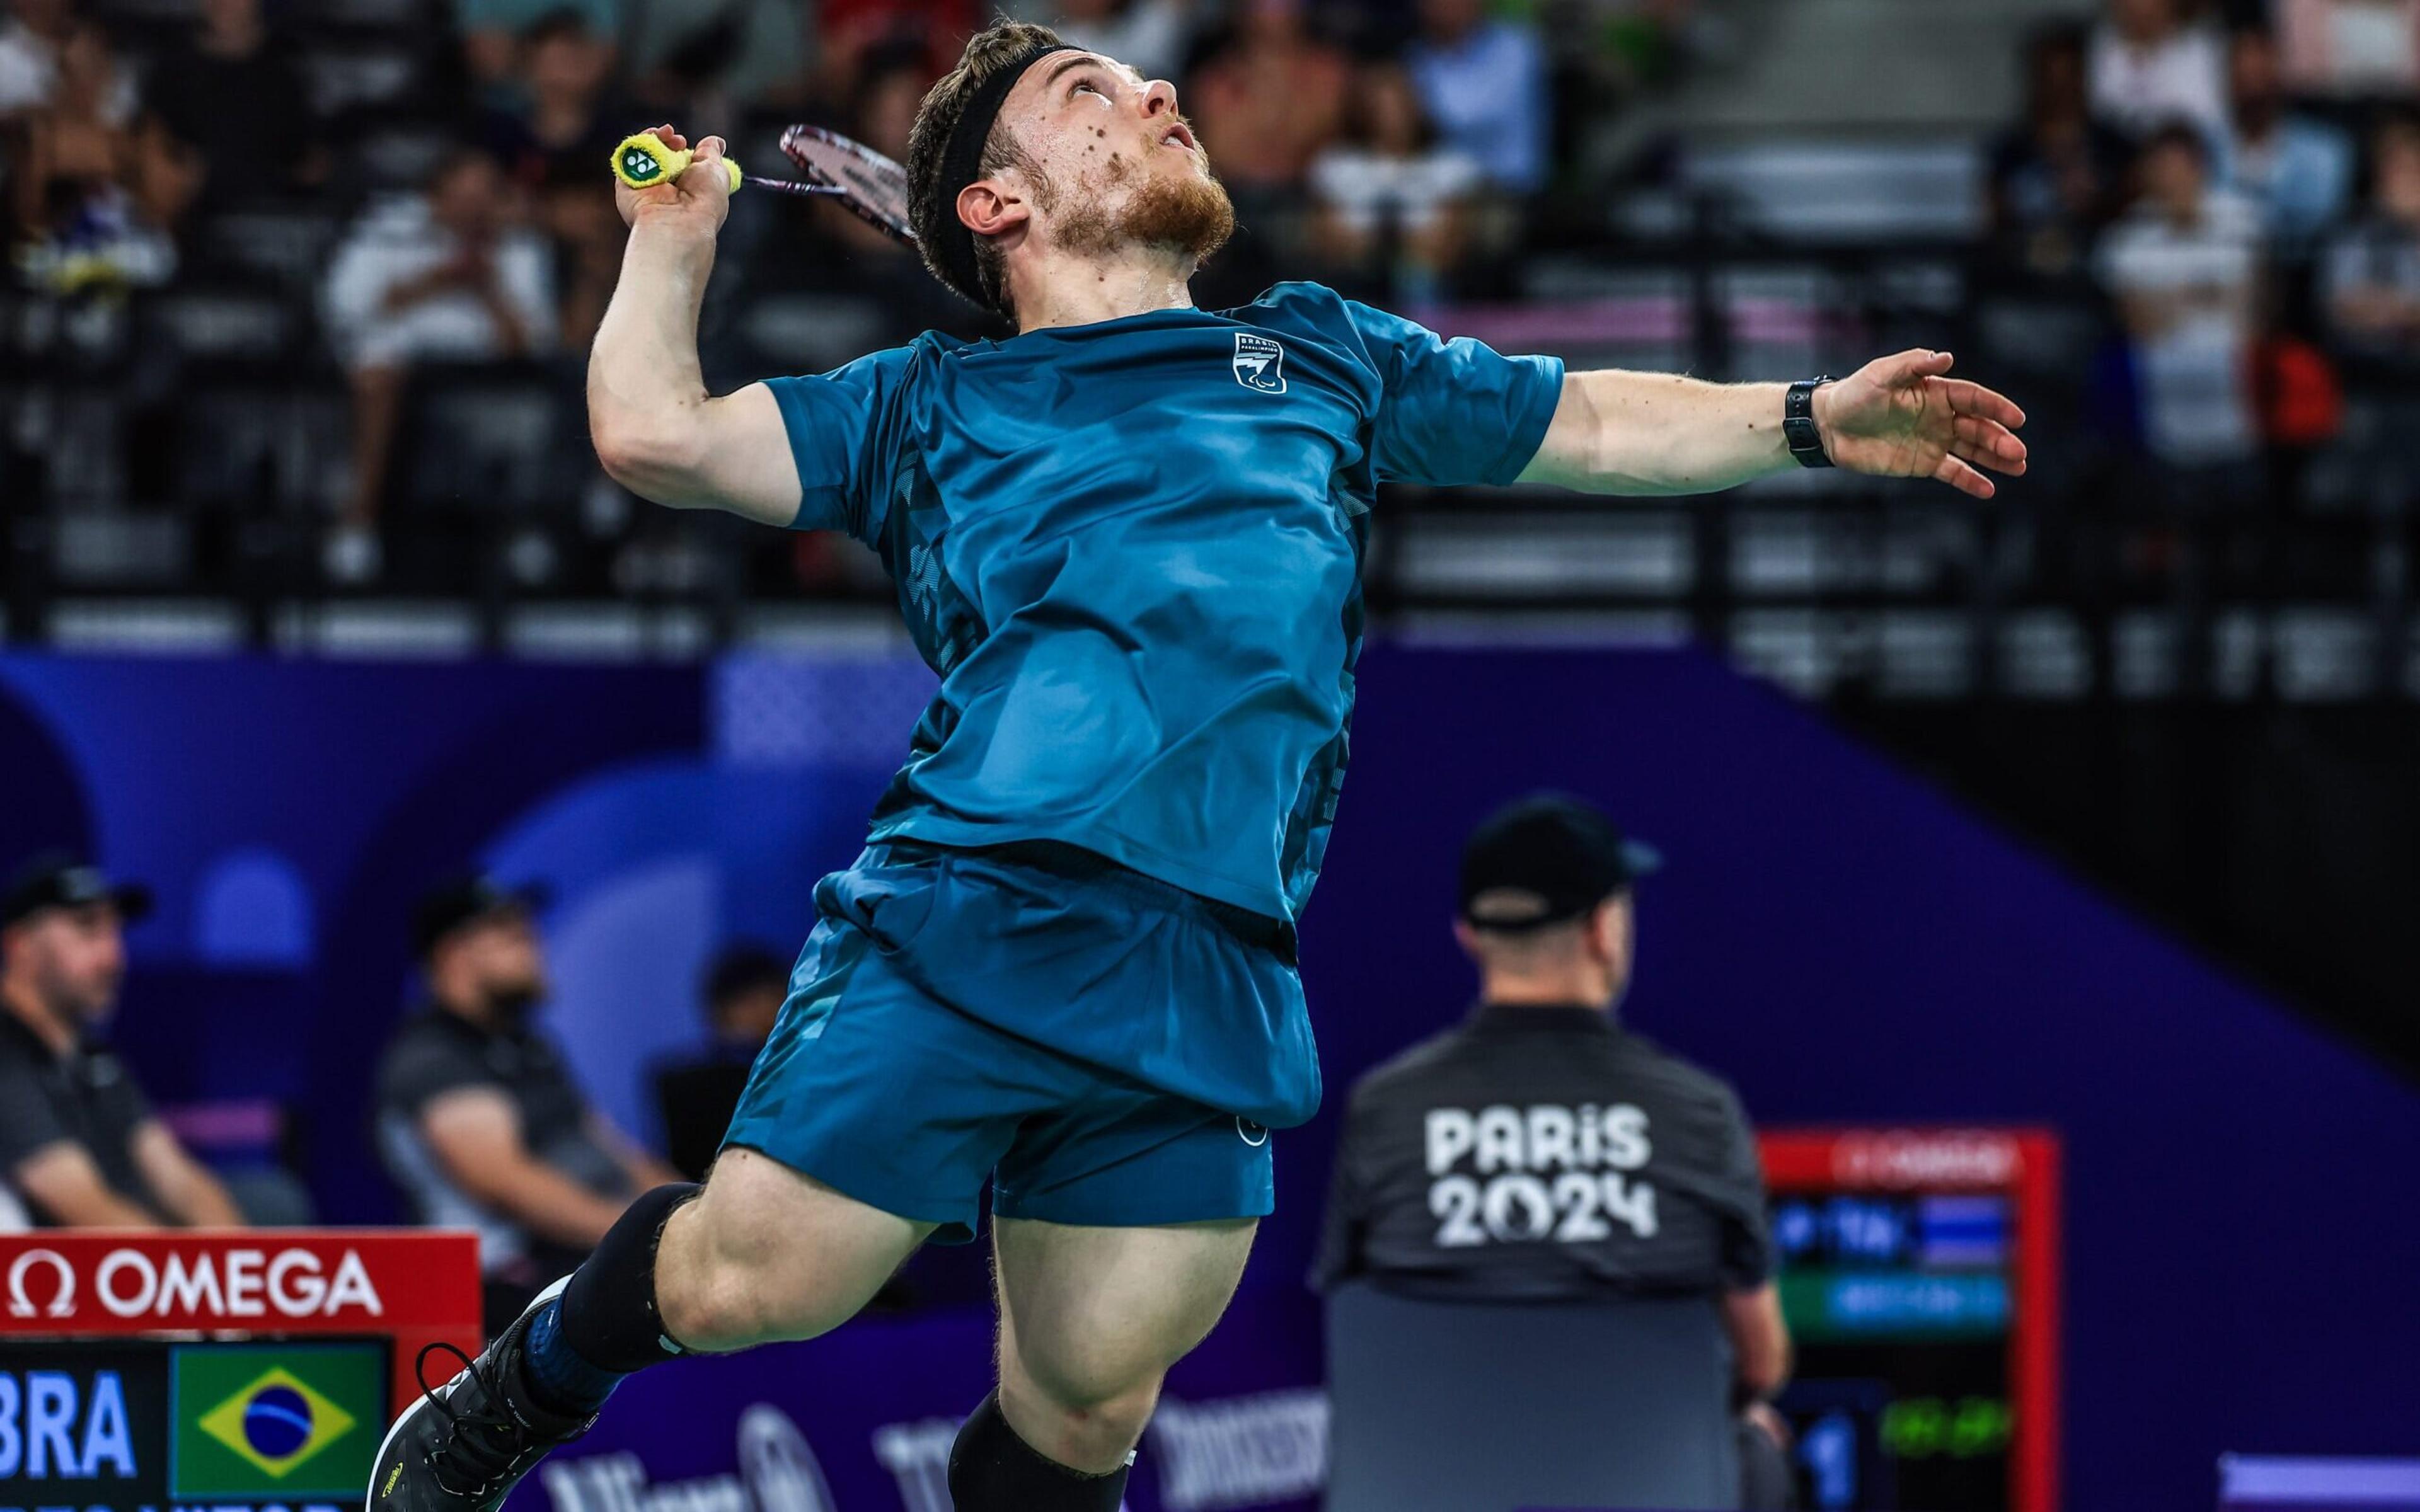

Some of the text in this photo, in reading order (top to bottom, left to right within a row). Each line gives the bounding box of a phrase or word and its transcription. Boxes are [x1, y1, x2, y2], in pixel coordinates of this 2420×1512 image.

[1241, 338, 1277, 347] BRASIL
[1428, 1172, 1659, 1248] 2024
[96, 1248, 383, 1317] OMEGA
